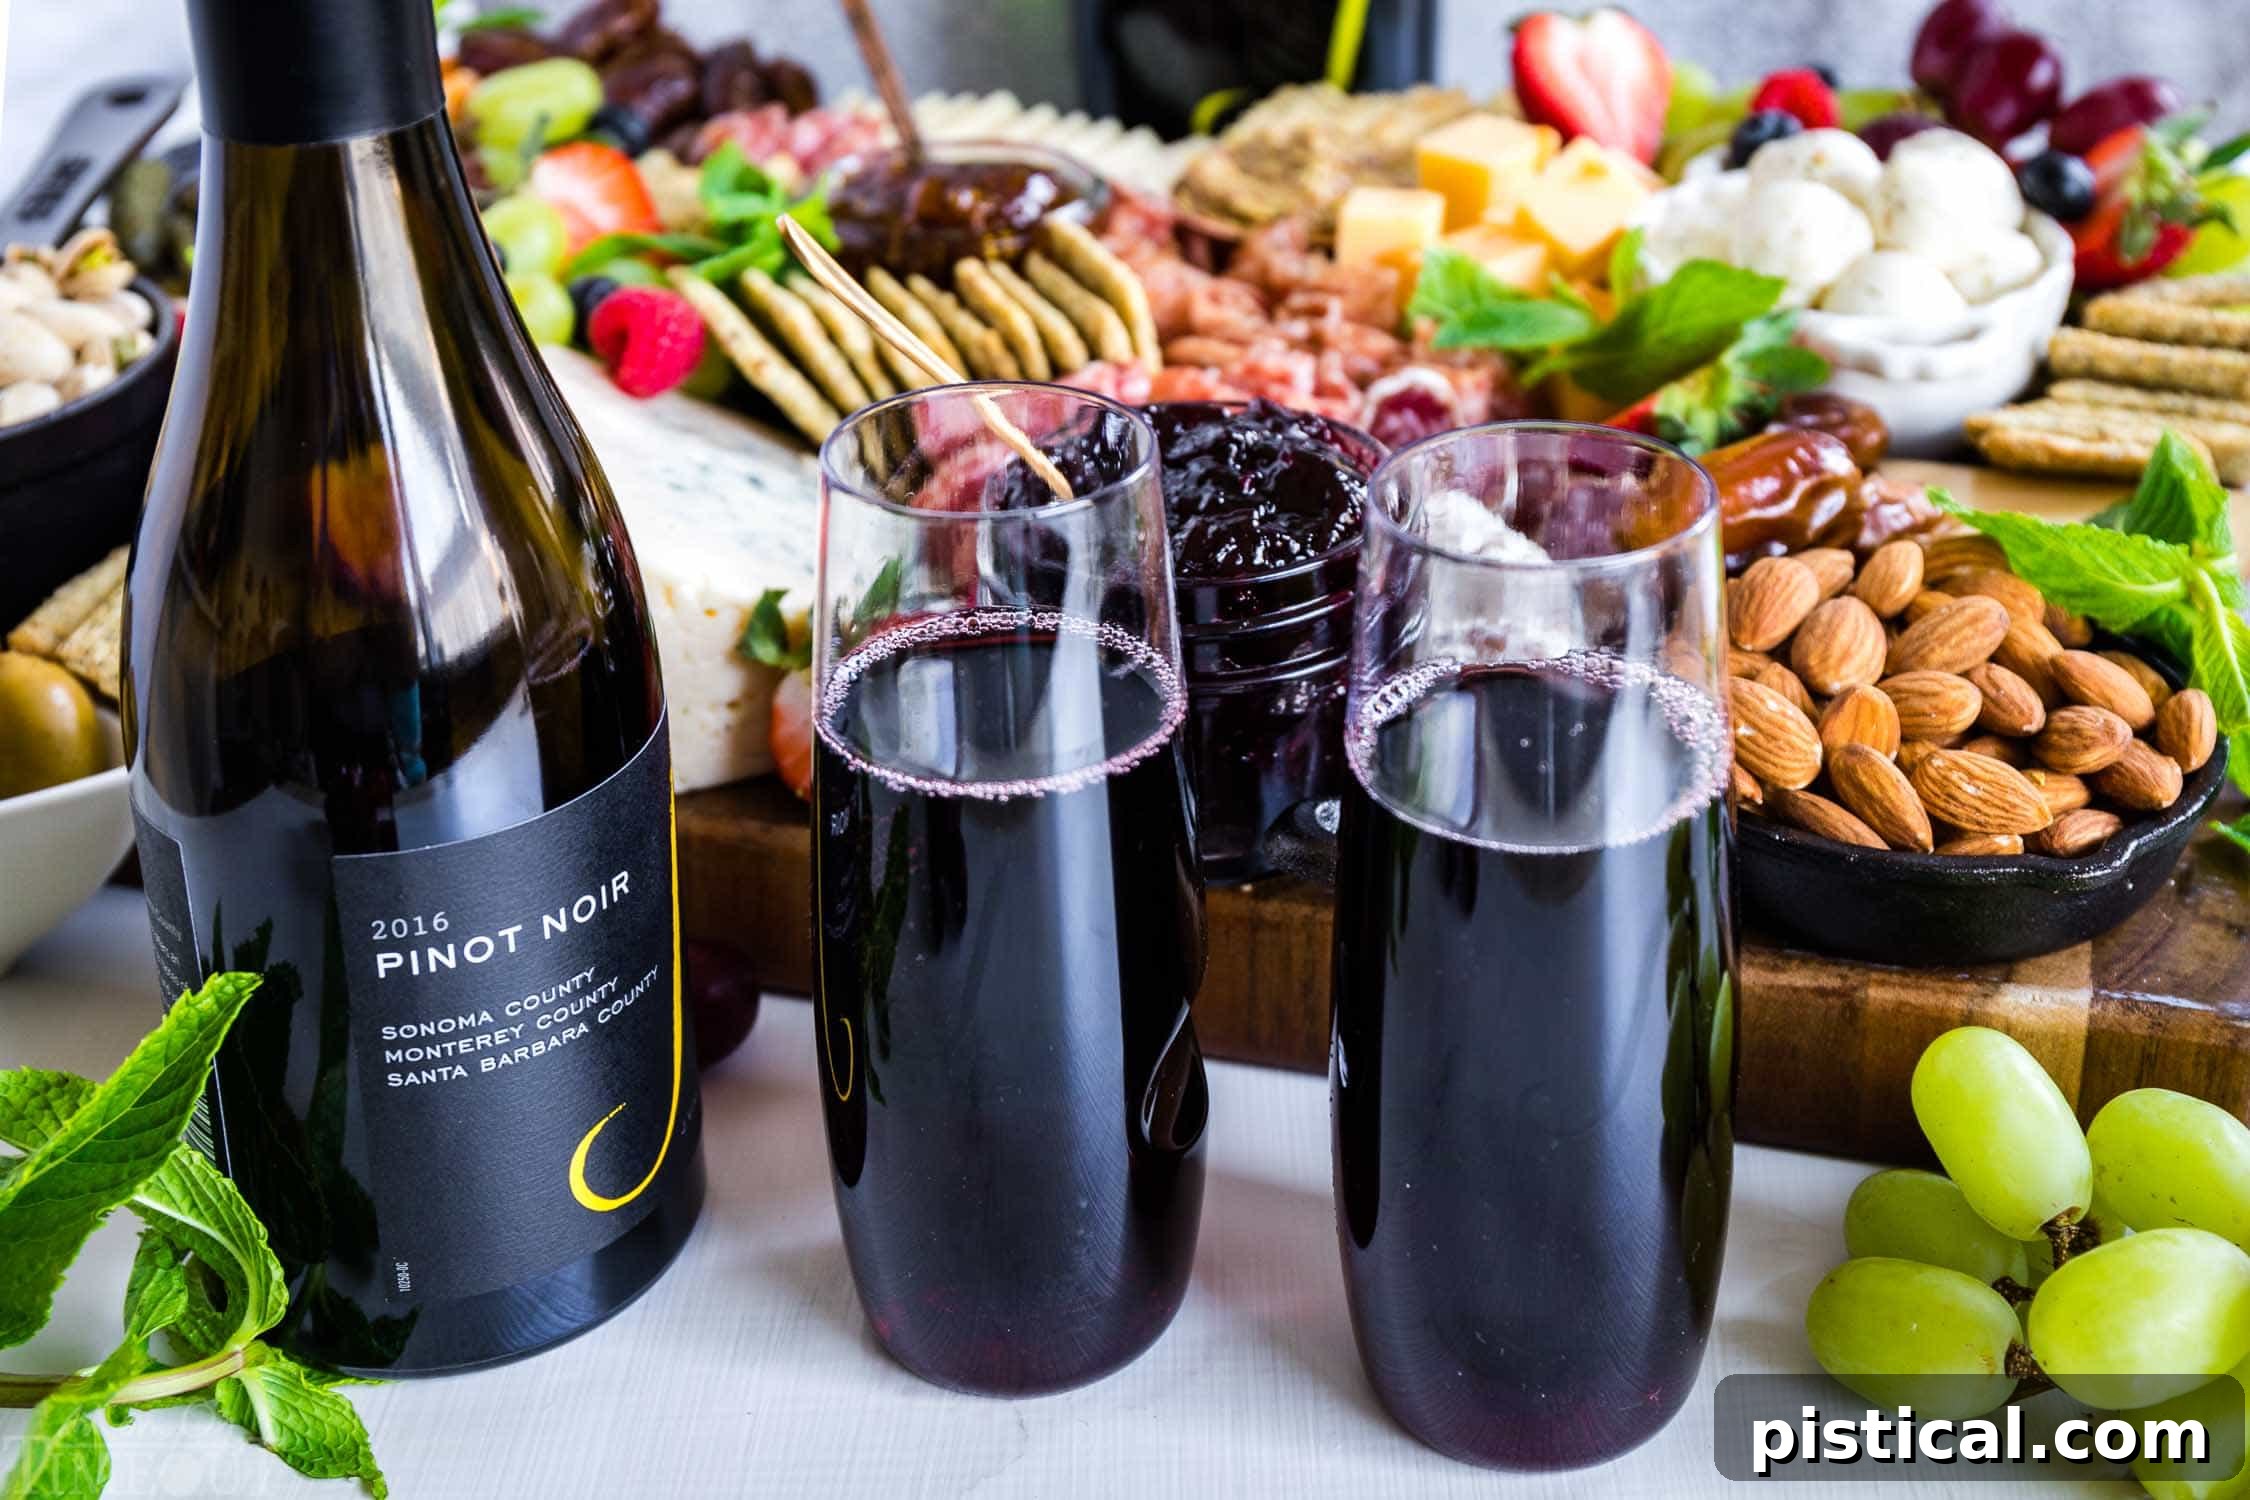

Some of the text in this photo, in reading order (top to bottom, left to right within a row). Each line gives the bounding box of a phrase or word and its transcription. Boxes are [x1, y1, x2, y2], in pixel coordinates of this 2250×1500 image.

[371, 911, 449, 941] 2016
[376, 870, 630, 979] PINOT NOIR
[381, 966, 595, 1041] SONOMA COUNTY
[385, 977, 619, 1064] MONTEREY COUNTY
[387, 964, 659, 1088] SANTA BARBARA COUNTY
